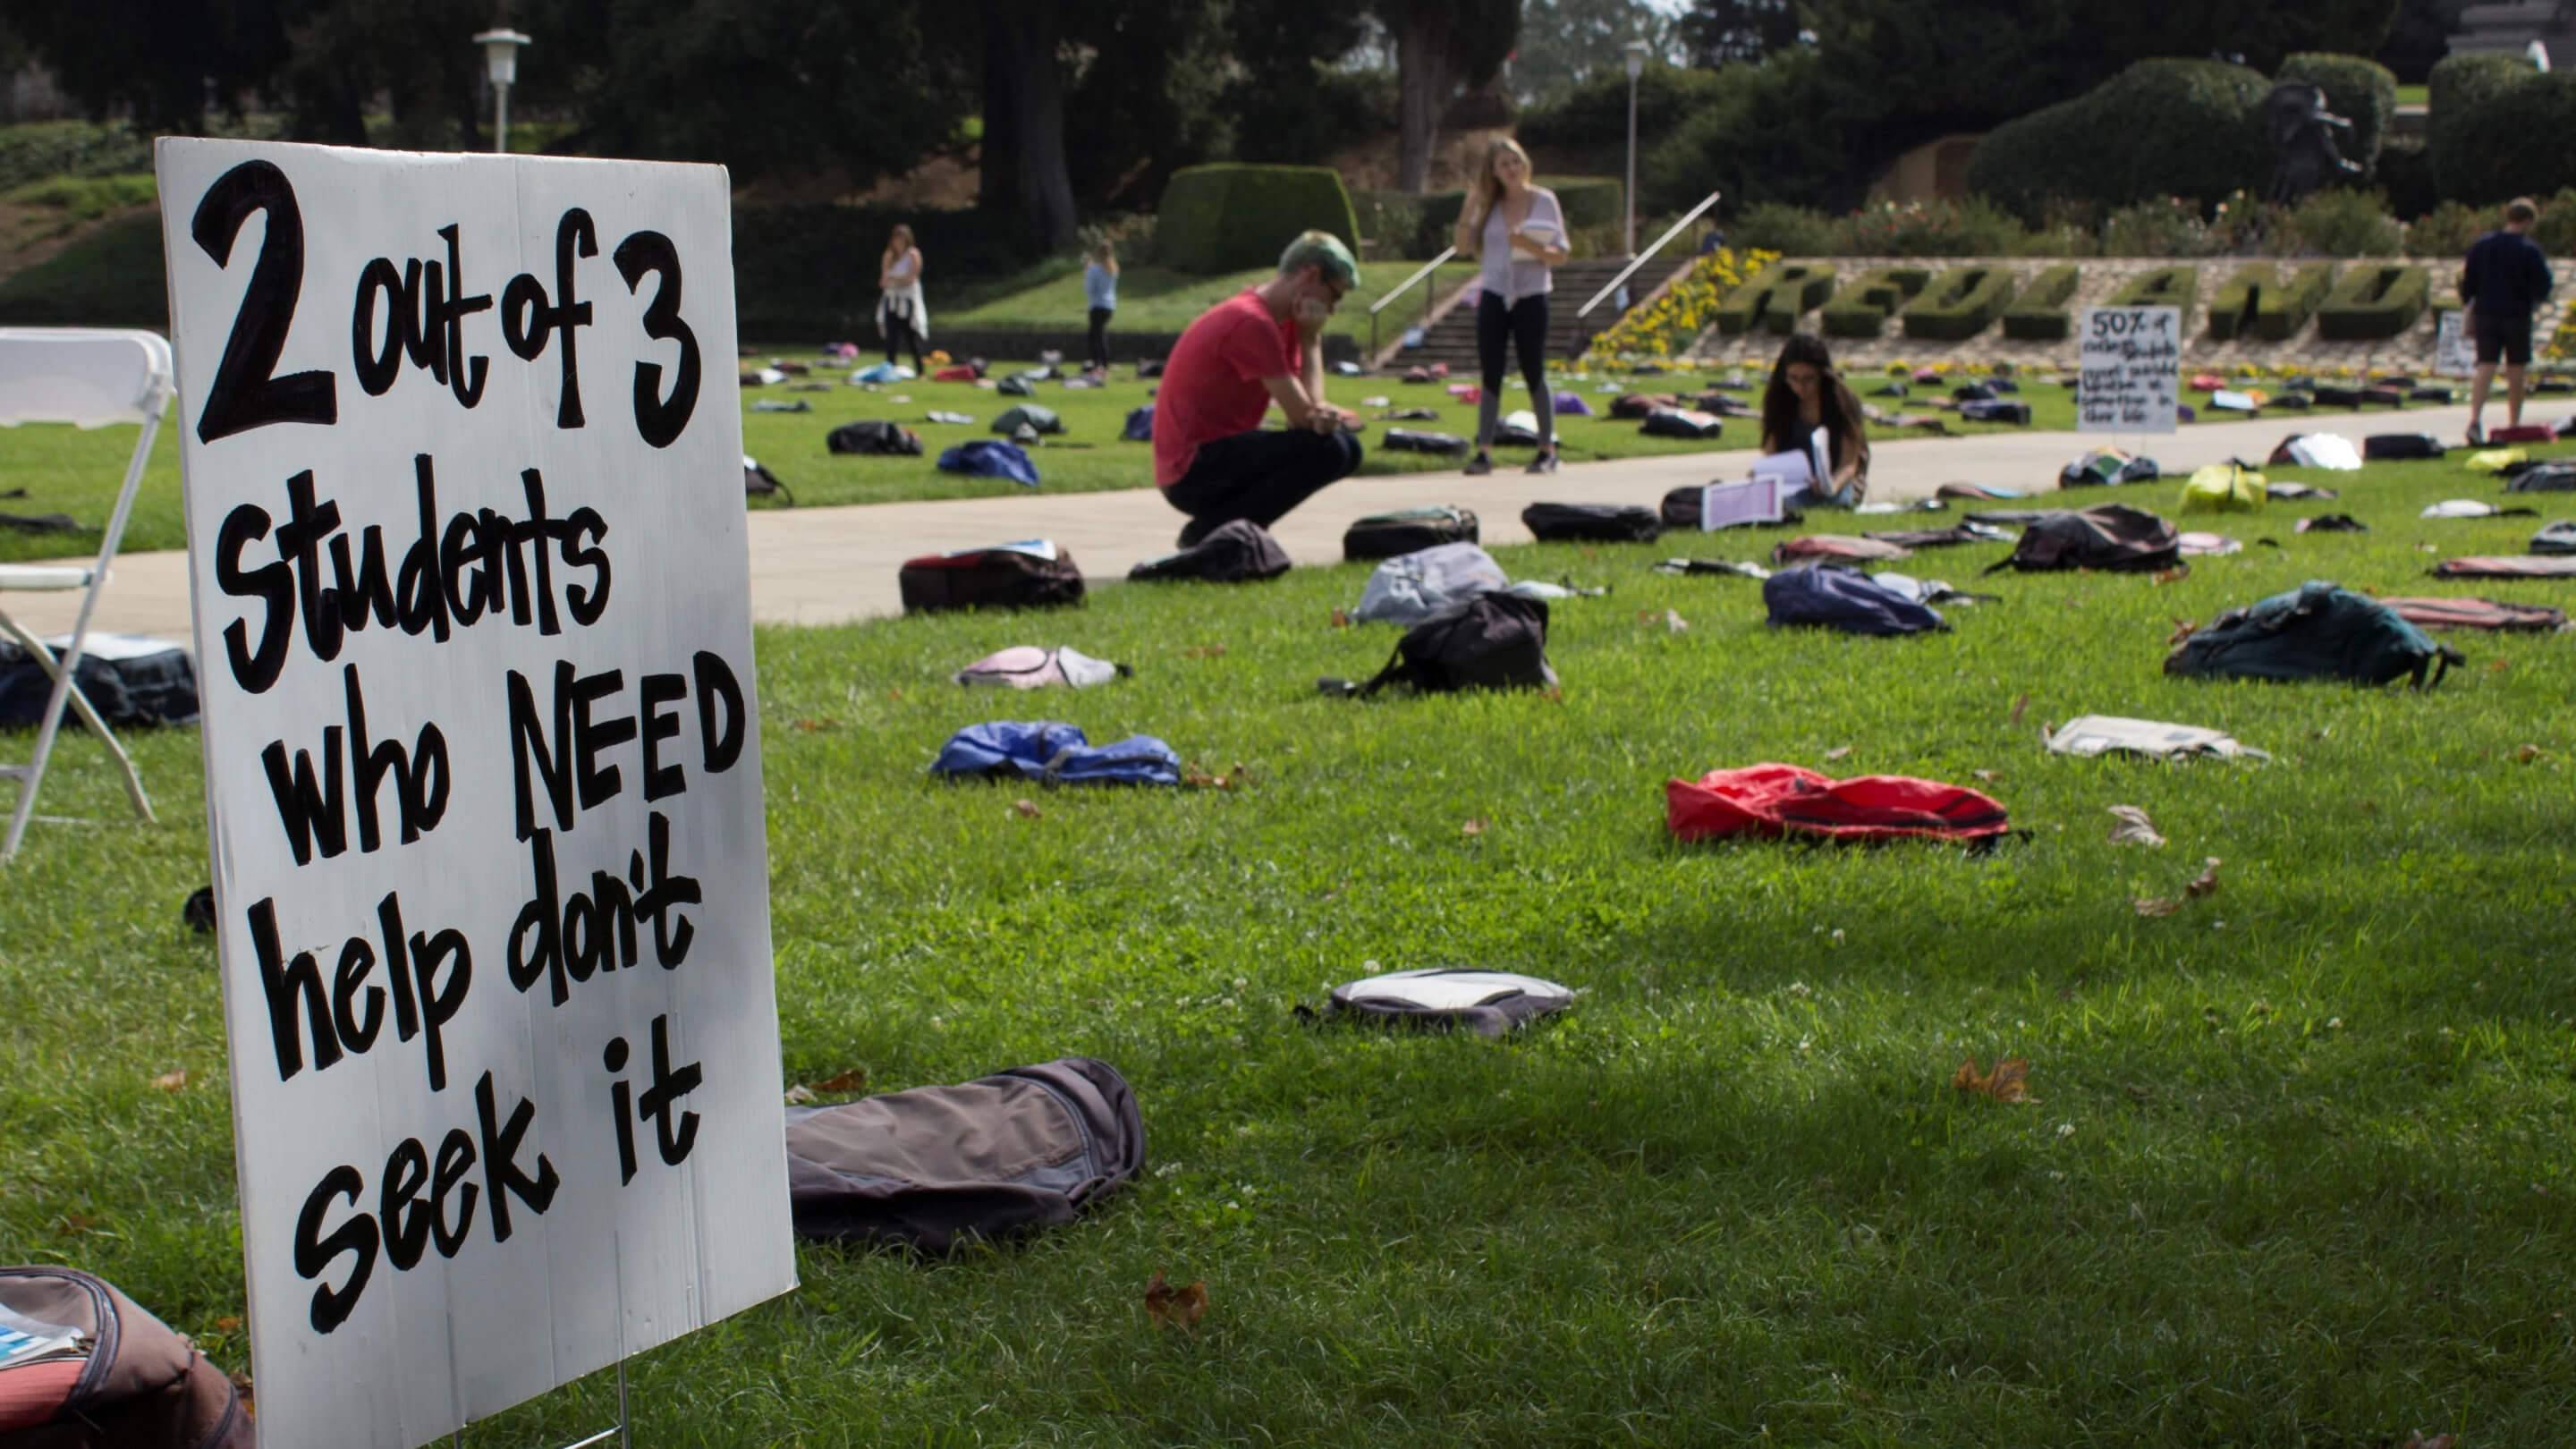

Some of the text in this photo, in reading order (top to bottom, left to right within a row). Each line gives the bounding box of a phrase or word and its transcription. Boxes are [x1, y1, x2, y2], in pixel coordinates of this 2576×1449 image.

[191, 159, 701, 448] 2 out of 3
[1716, 265, 2470, 342] REDLAND
[2092, 311, 2147, 337] 50%
[261, 650, 745, 866] who NEED
[248, 811, 701, 1091] help don't
[604, 1014, 701, 1186] it
